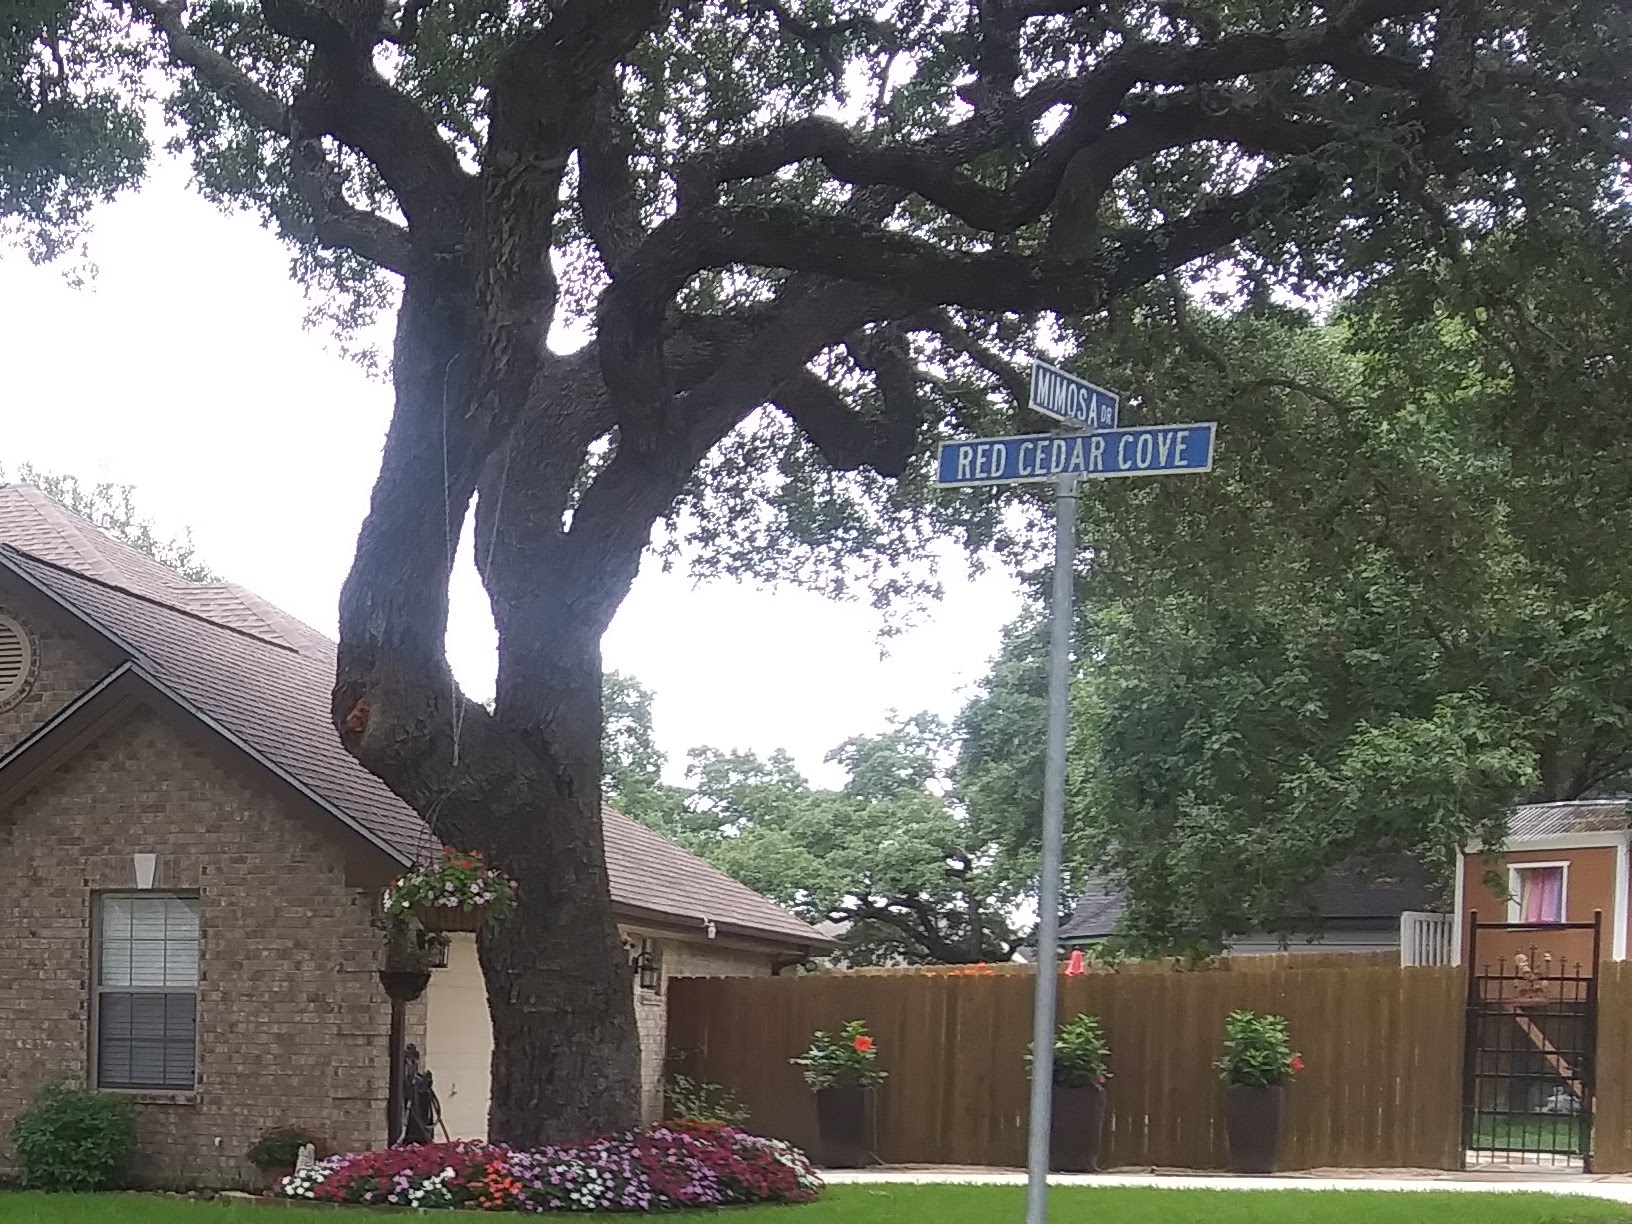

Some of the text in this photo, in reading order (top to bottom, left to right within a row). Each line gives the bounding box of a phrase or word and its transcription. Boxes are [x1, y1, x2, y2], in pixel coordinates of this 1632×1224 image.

[1036, 367, 1113, 428] MIMOSA DR
[958, 430, 1190, 479] RED CEDAR COVE
